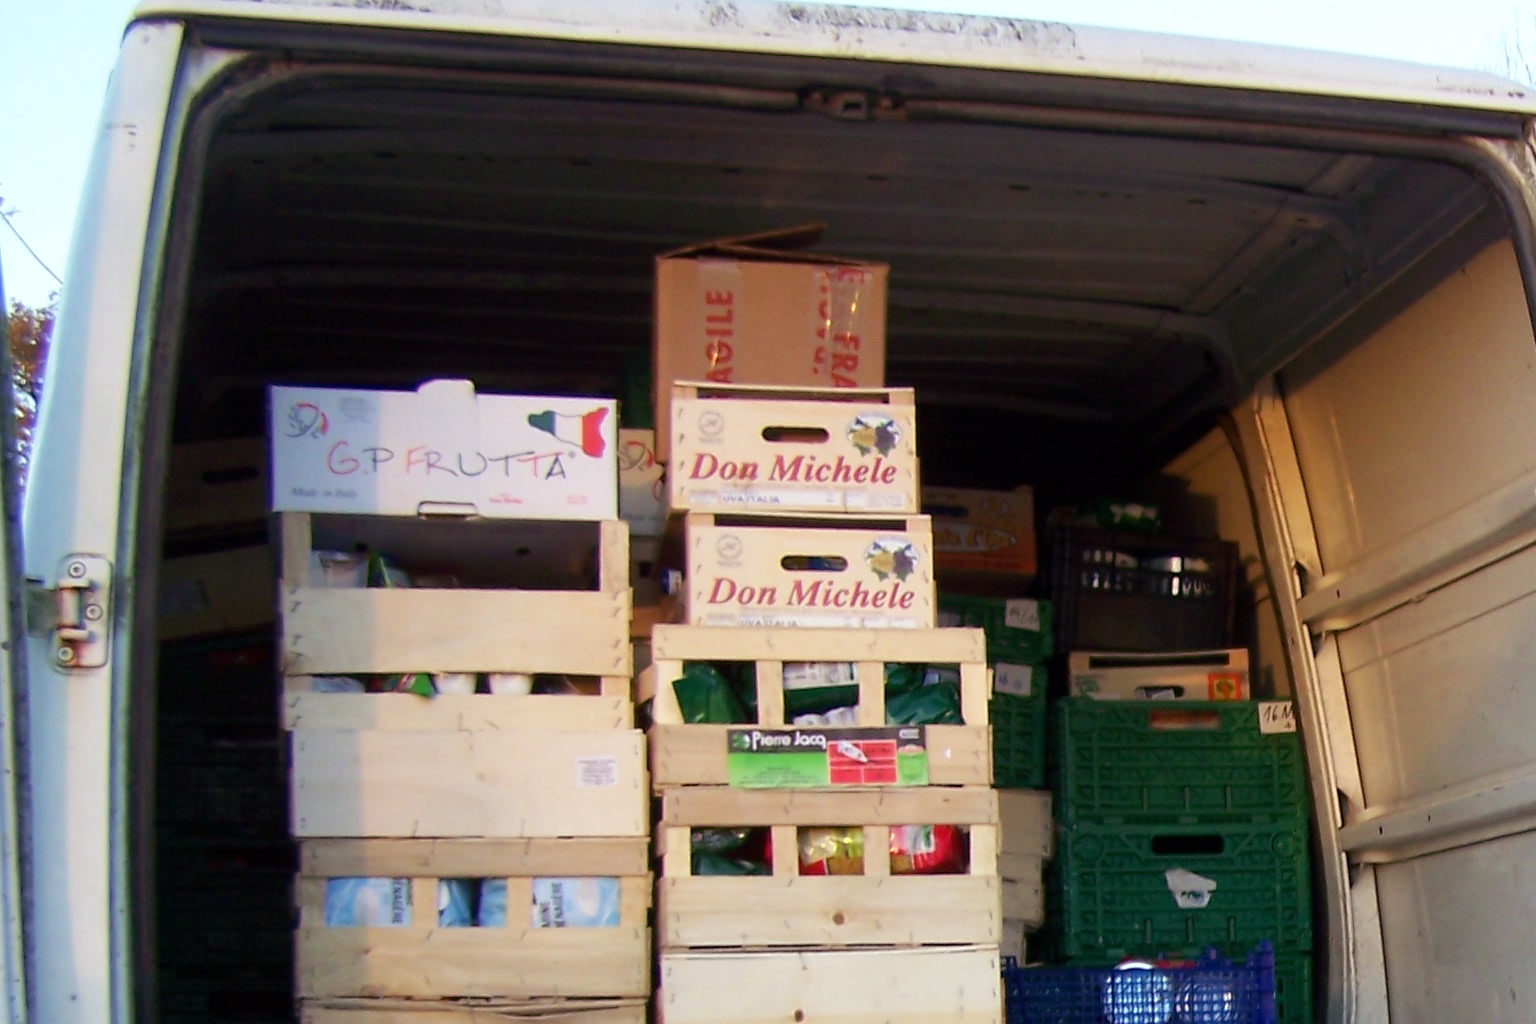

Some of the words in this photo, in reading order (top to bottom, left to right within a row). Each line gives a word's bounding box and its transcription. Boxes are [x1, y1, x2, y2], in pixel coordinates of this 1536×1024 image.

[704, 289, 734, 384] AGILE
[404, 446, 567, 480] FRUTTA
[689, 452, 759, 482] Don
[768, 453, 898, 485] Michele
[707, 577, 777, 607] Don
[787, 578, 916, 611] Michele
[751, 730, 792, 751] Pierre
